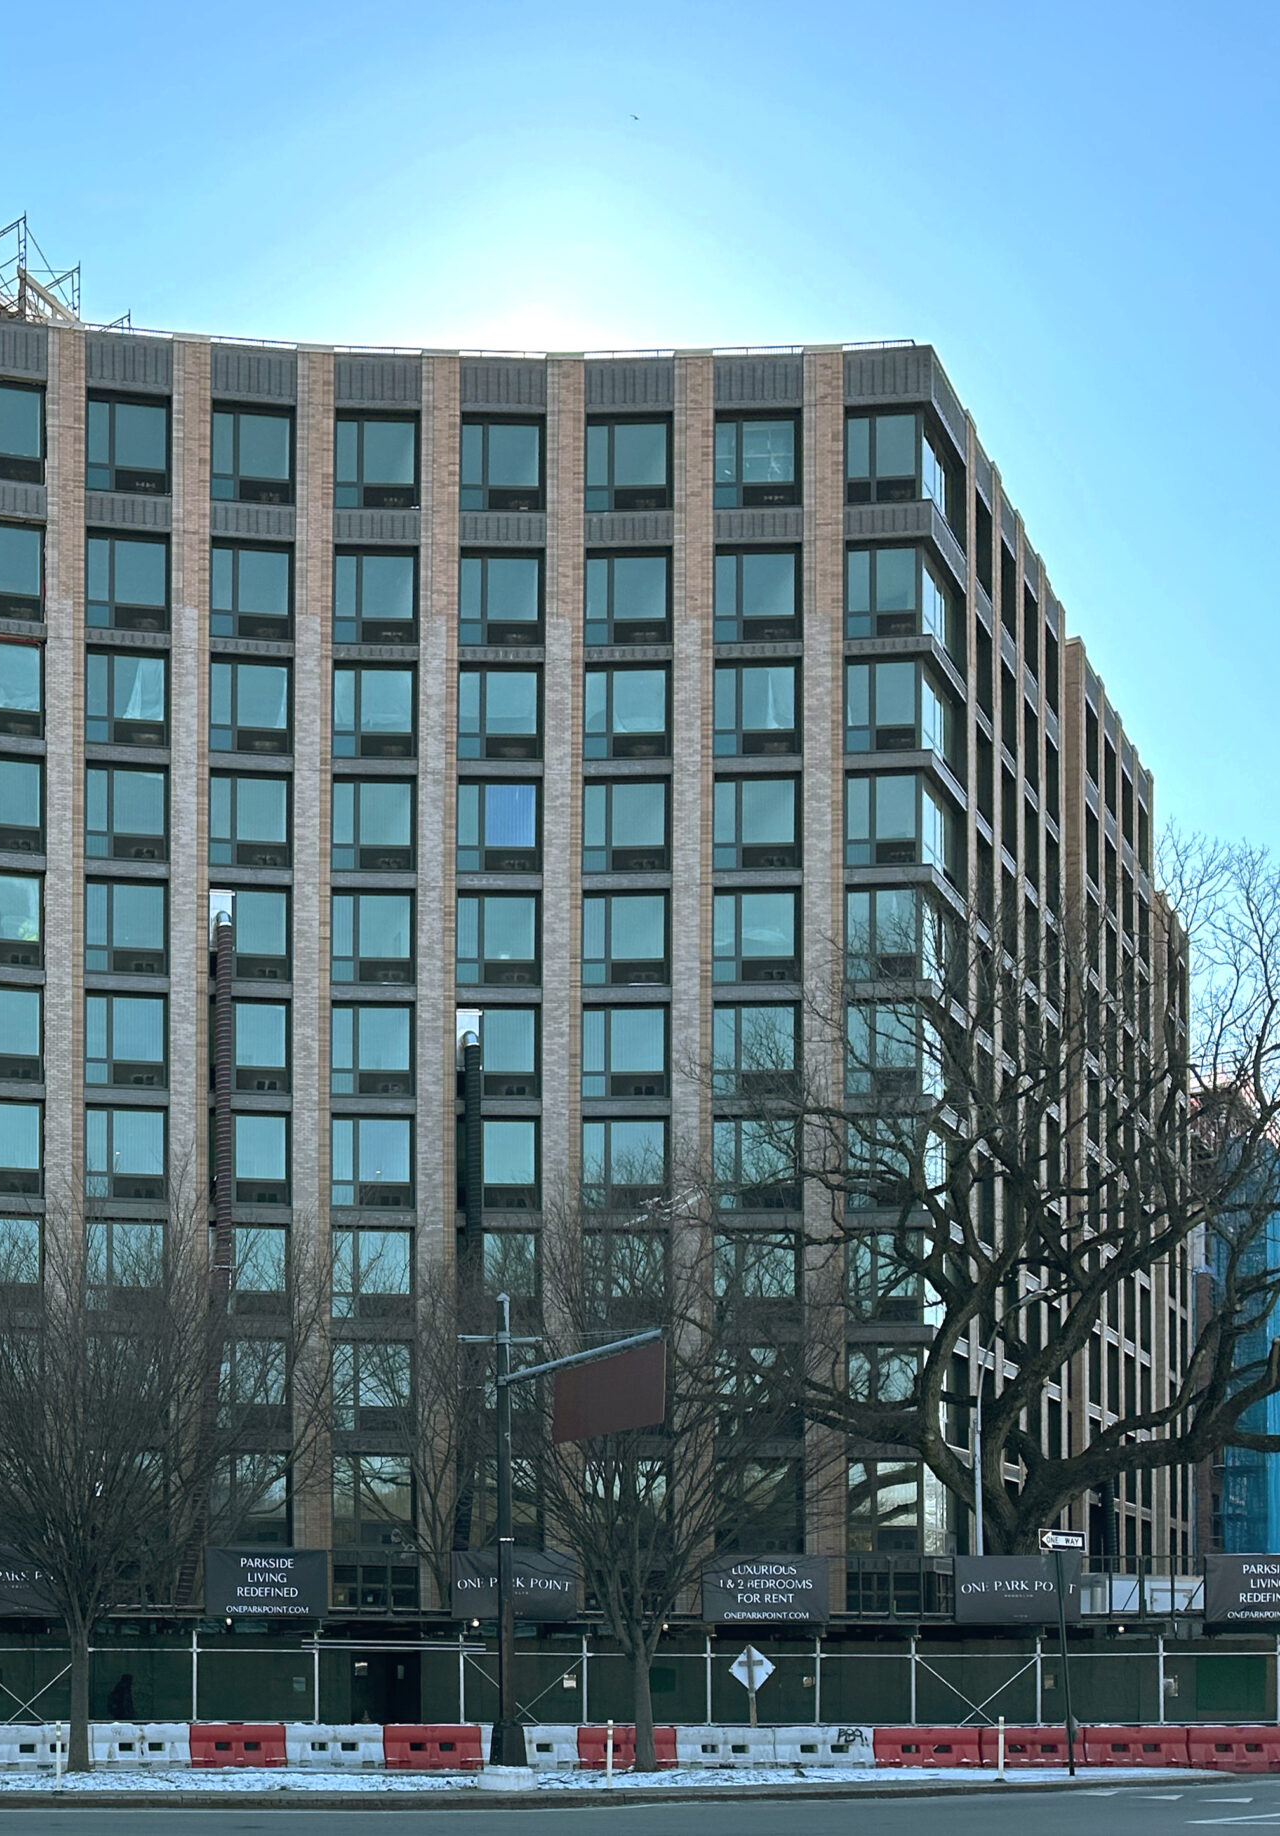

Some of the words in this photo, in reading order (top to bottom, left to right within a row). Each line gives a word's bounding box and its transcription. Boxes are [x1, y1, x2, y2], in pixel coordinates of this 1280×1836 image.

[240, 1557, 294, 1569] PARKSIDE
[732, 1564, 797, 1575] LUXURIOUS
[1242, 1564, 1280, 1574] PARKSI
[247, 1572, 287, 1583] LIVING
[489, 1577, 525, 1588] PK
[530, 1577, 572, 1592] POINT
[726, 1579, 735, 1589] &
[738, 1579, 744, 1589] 2
[747, 1579, 813, 1589] BEDROOMS
[961, 1581, 990, 1594] ONE
[994, 1580, 1029, 1592] PARK
[1250, 1578, 1280, 1589] LIVIN
[236, 1587, 298, 1598] REDEFINED
[737, 1593, 761, 1604] FOR
[764, 1593, 794, 1604] RENT
[225, 1605, 309, 1614] ONEPARKPOINT.COM
[723, 1611, 810, 1620] ONEPARKPOINT.COM
